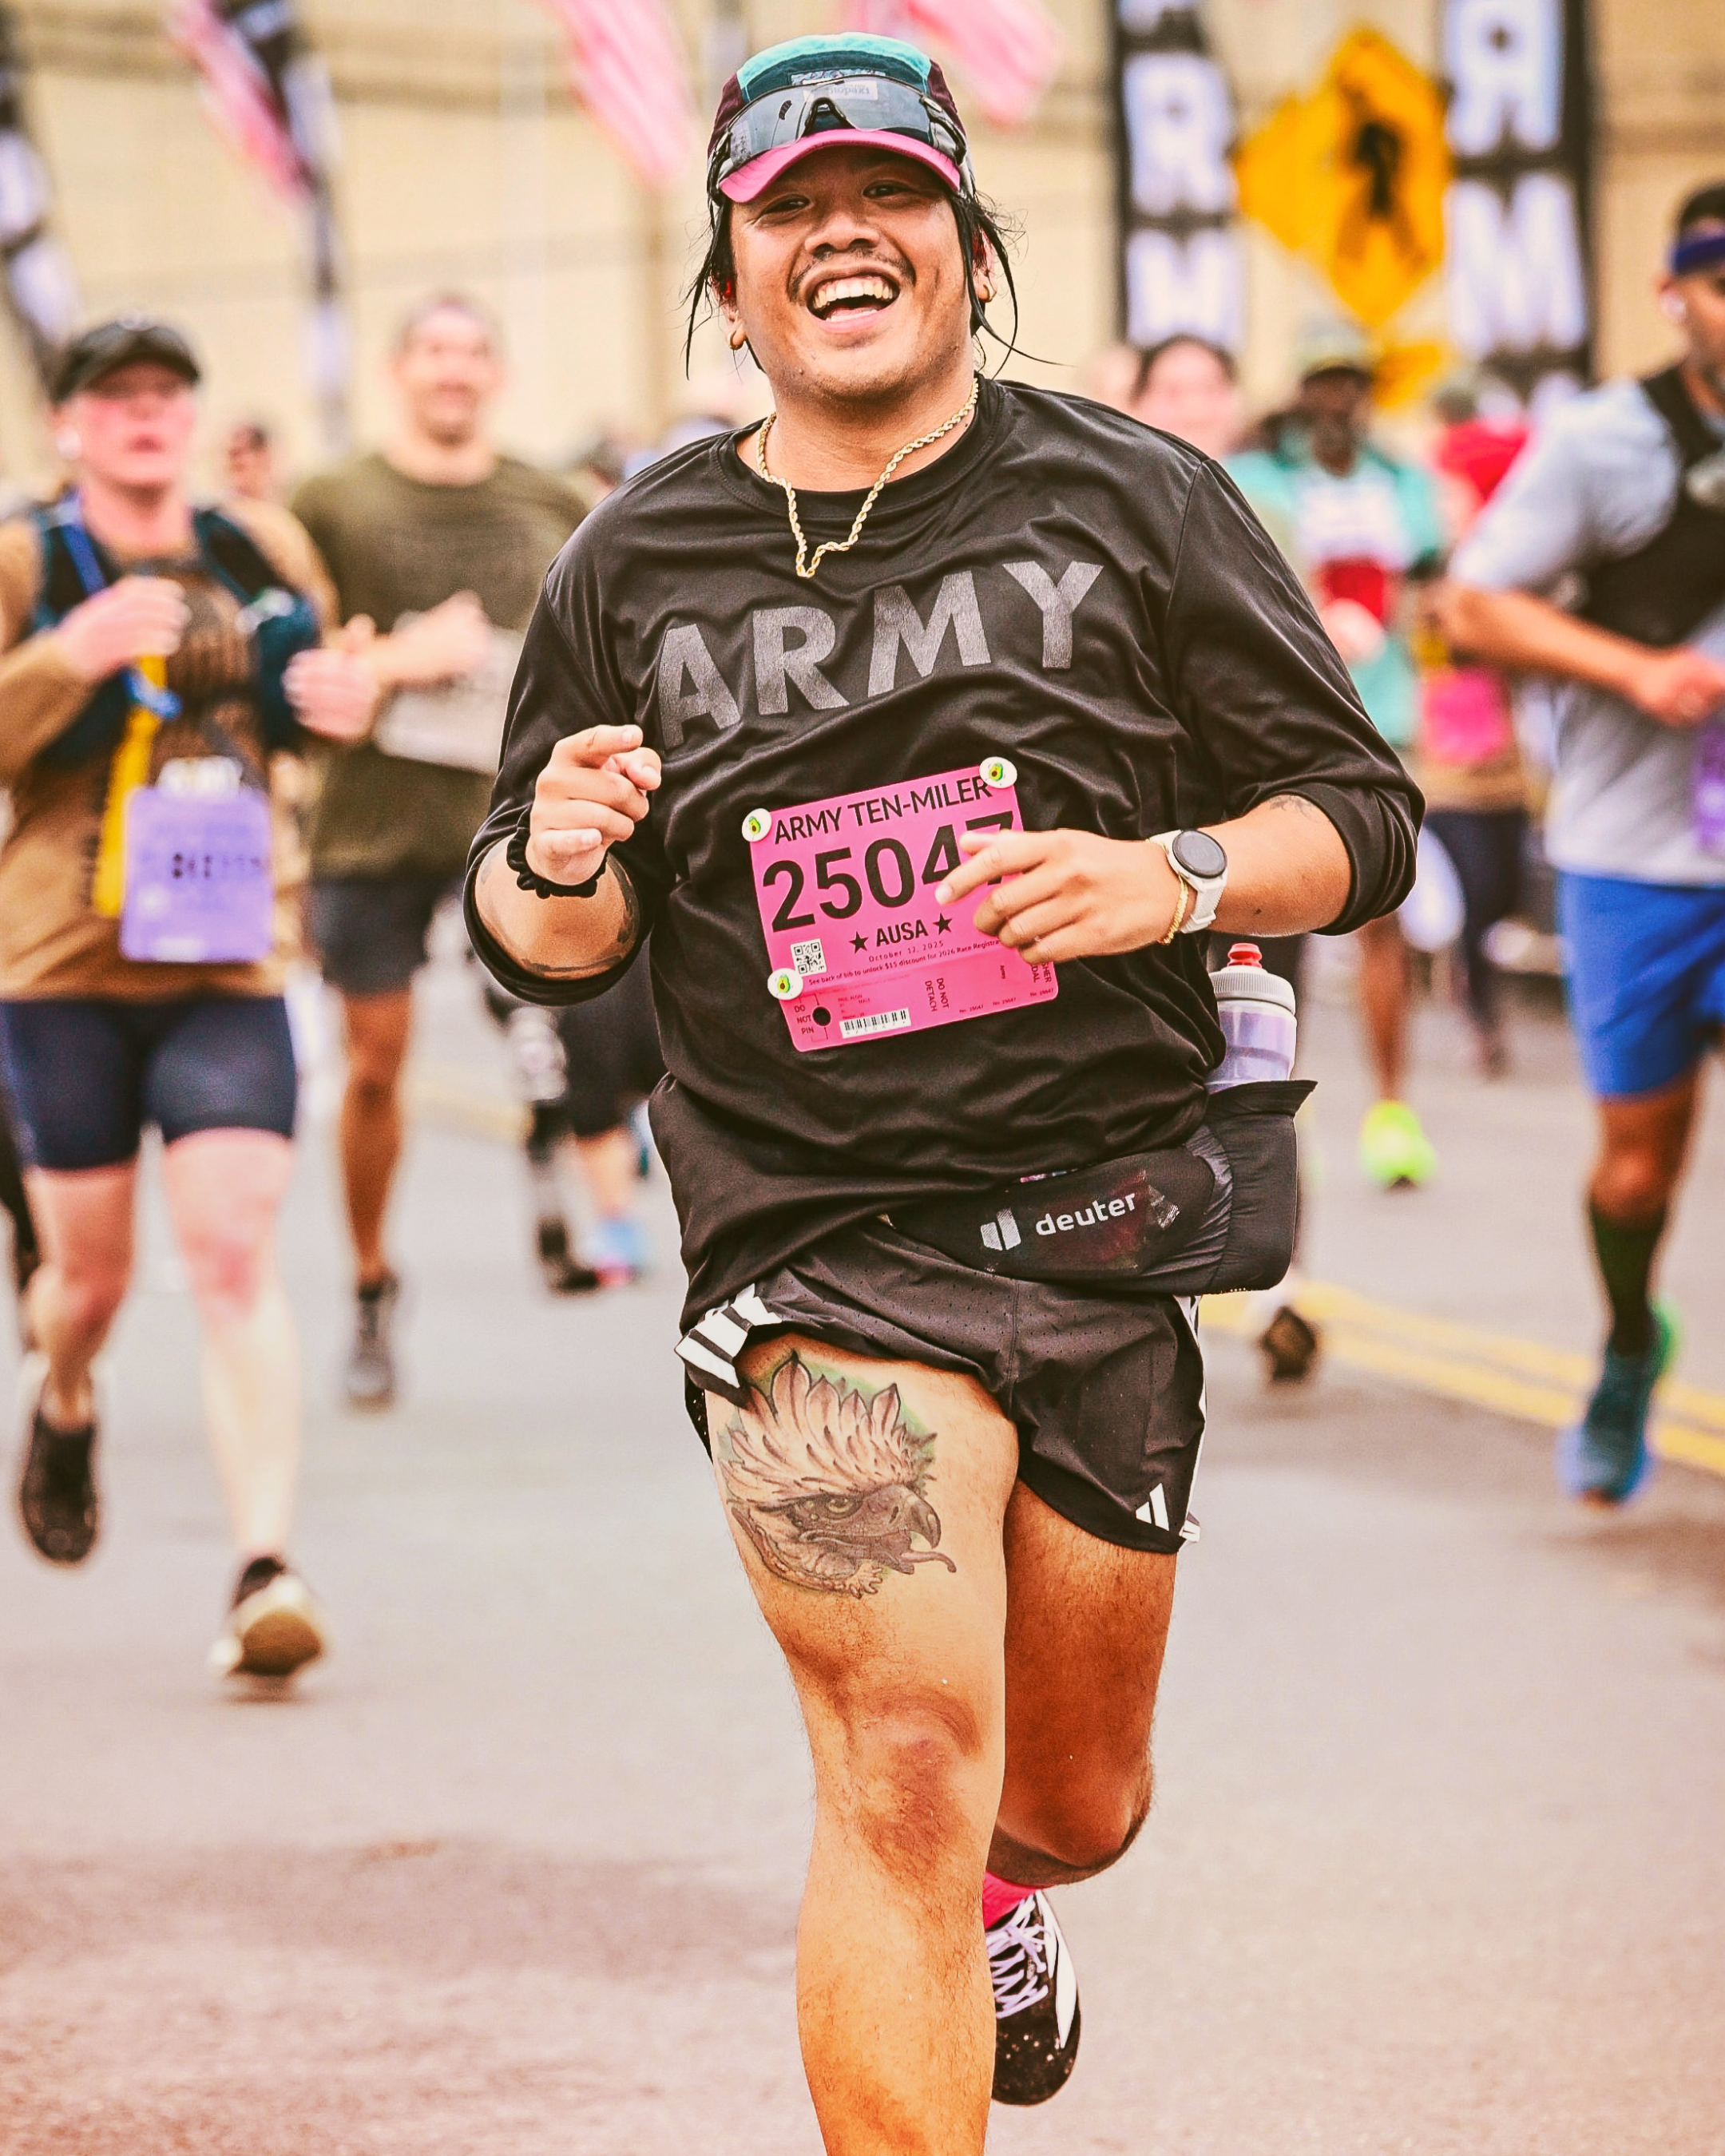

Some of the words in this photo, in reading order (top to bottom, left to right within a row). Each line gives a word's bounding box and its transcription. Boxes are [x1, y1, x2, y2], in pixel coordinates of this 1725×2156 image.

[658, 560, 1104, 750] ARMY
[775, 807, 843, 845] ARMY
[847, 775, 993, 828] TEN-MILER
[876, 918, 928, 948] AUSA
[862, 964, 883, 974] unlock
[885, 961, 897, 970] $15
[898, 956, 926, 966] discount
[973, 939, 1000, 950] Registra
[868, 951, 902, 963] October
[922, 940, 944, 951] 2025
[1030, 963, 1041, 983] DAL
[1041, 961, 1052, 983] SHER
[936, 977, 946, 990] DO
[924, 980, 938, 1013] DETACH
[940, 992, 950, 1009] NOT
[794, 1004, 806, 1013] DO
[796, 1014, 812, 1024] NOT
[801, 1026, 815, 1035] PIN
[1036, 1192, 1136, 1237] deuter
